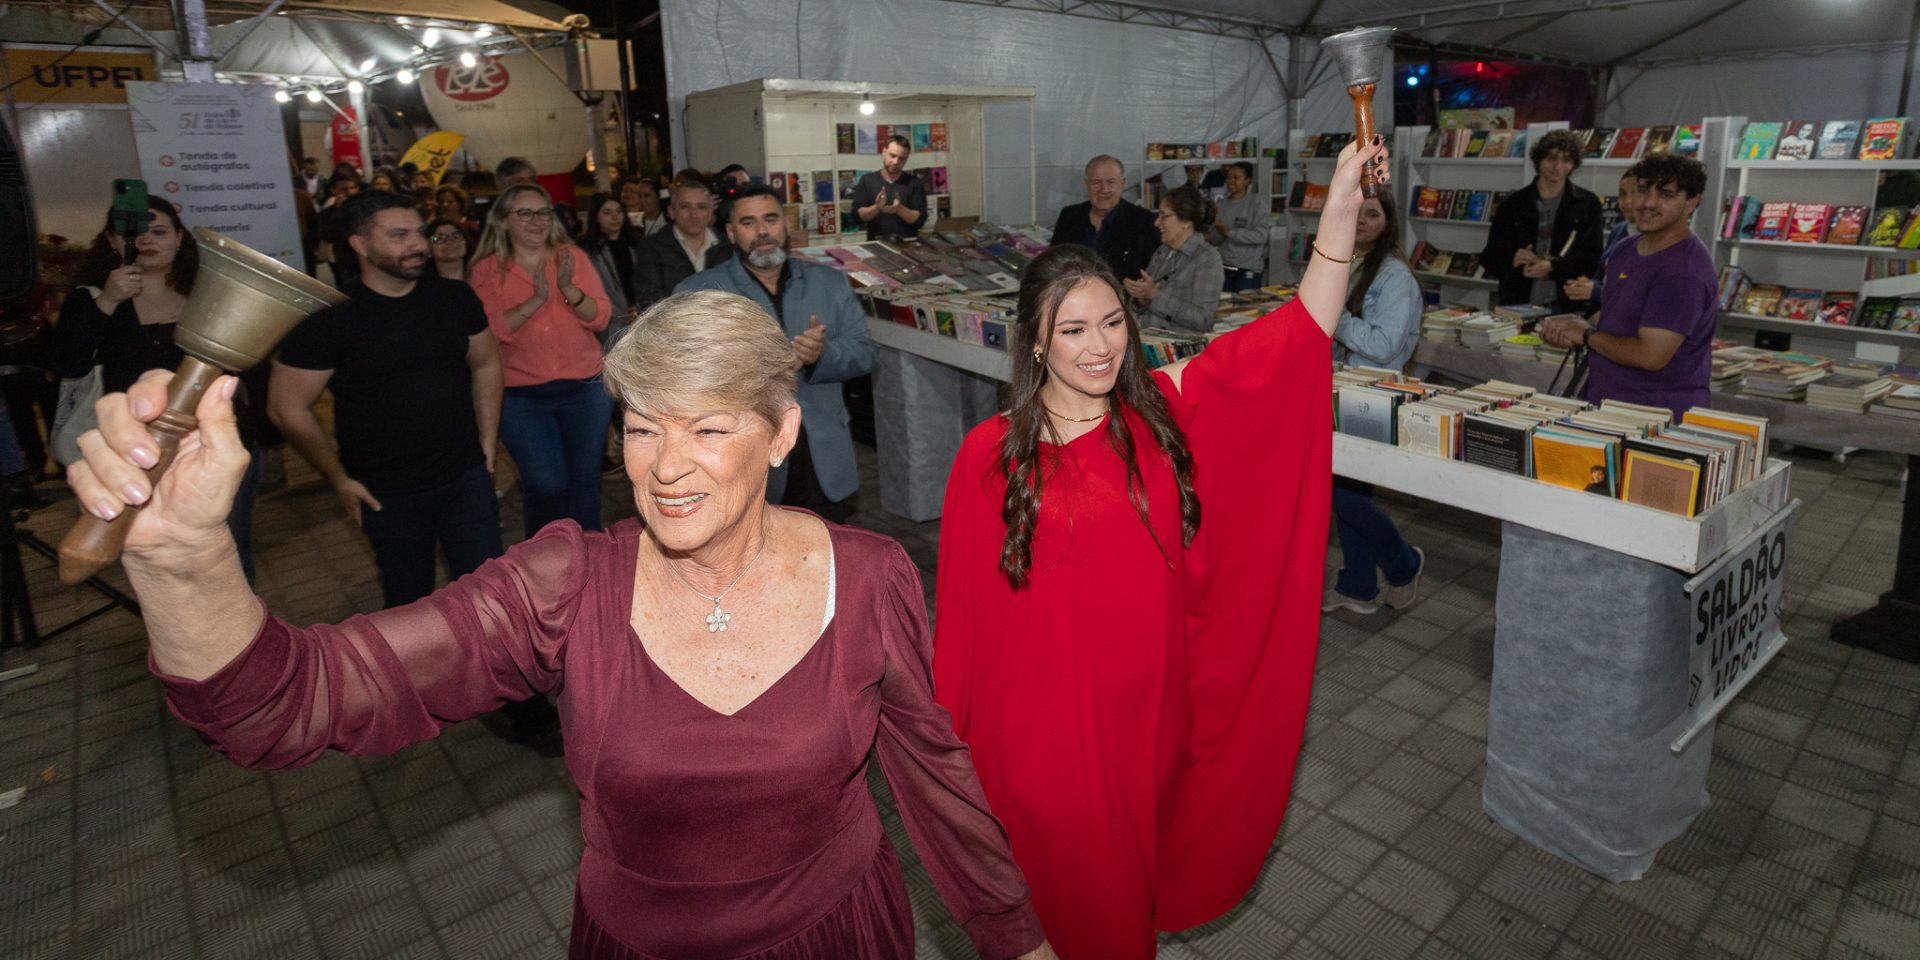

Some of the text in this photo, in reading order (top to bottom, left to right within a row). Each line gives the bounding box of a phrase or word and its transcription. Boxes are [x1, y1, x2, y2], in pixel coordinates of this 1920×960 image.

[179, 152, 237, 160] Tenda de
[181, 162, 250, 173] autógrafos
[184, 182, 276, 192] Tenda coletiva
[188, 202, 277, 213] Tenda cultural
[1696, 531, 1786, 645] SALDÃO
[1711, 593, 1768, 668] LIVROS
[1713, 631, 1762, 699] LIDOS
